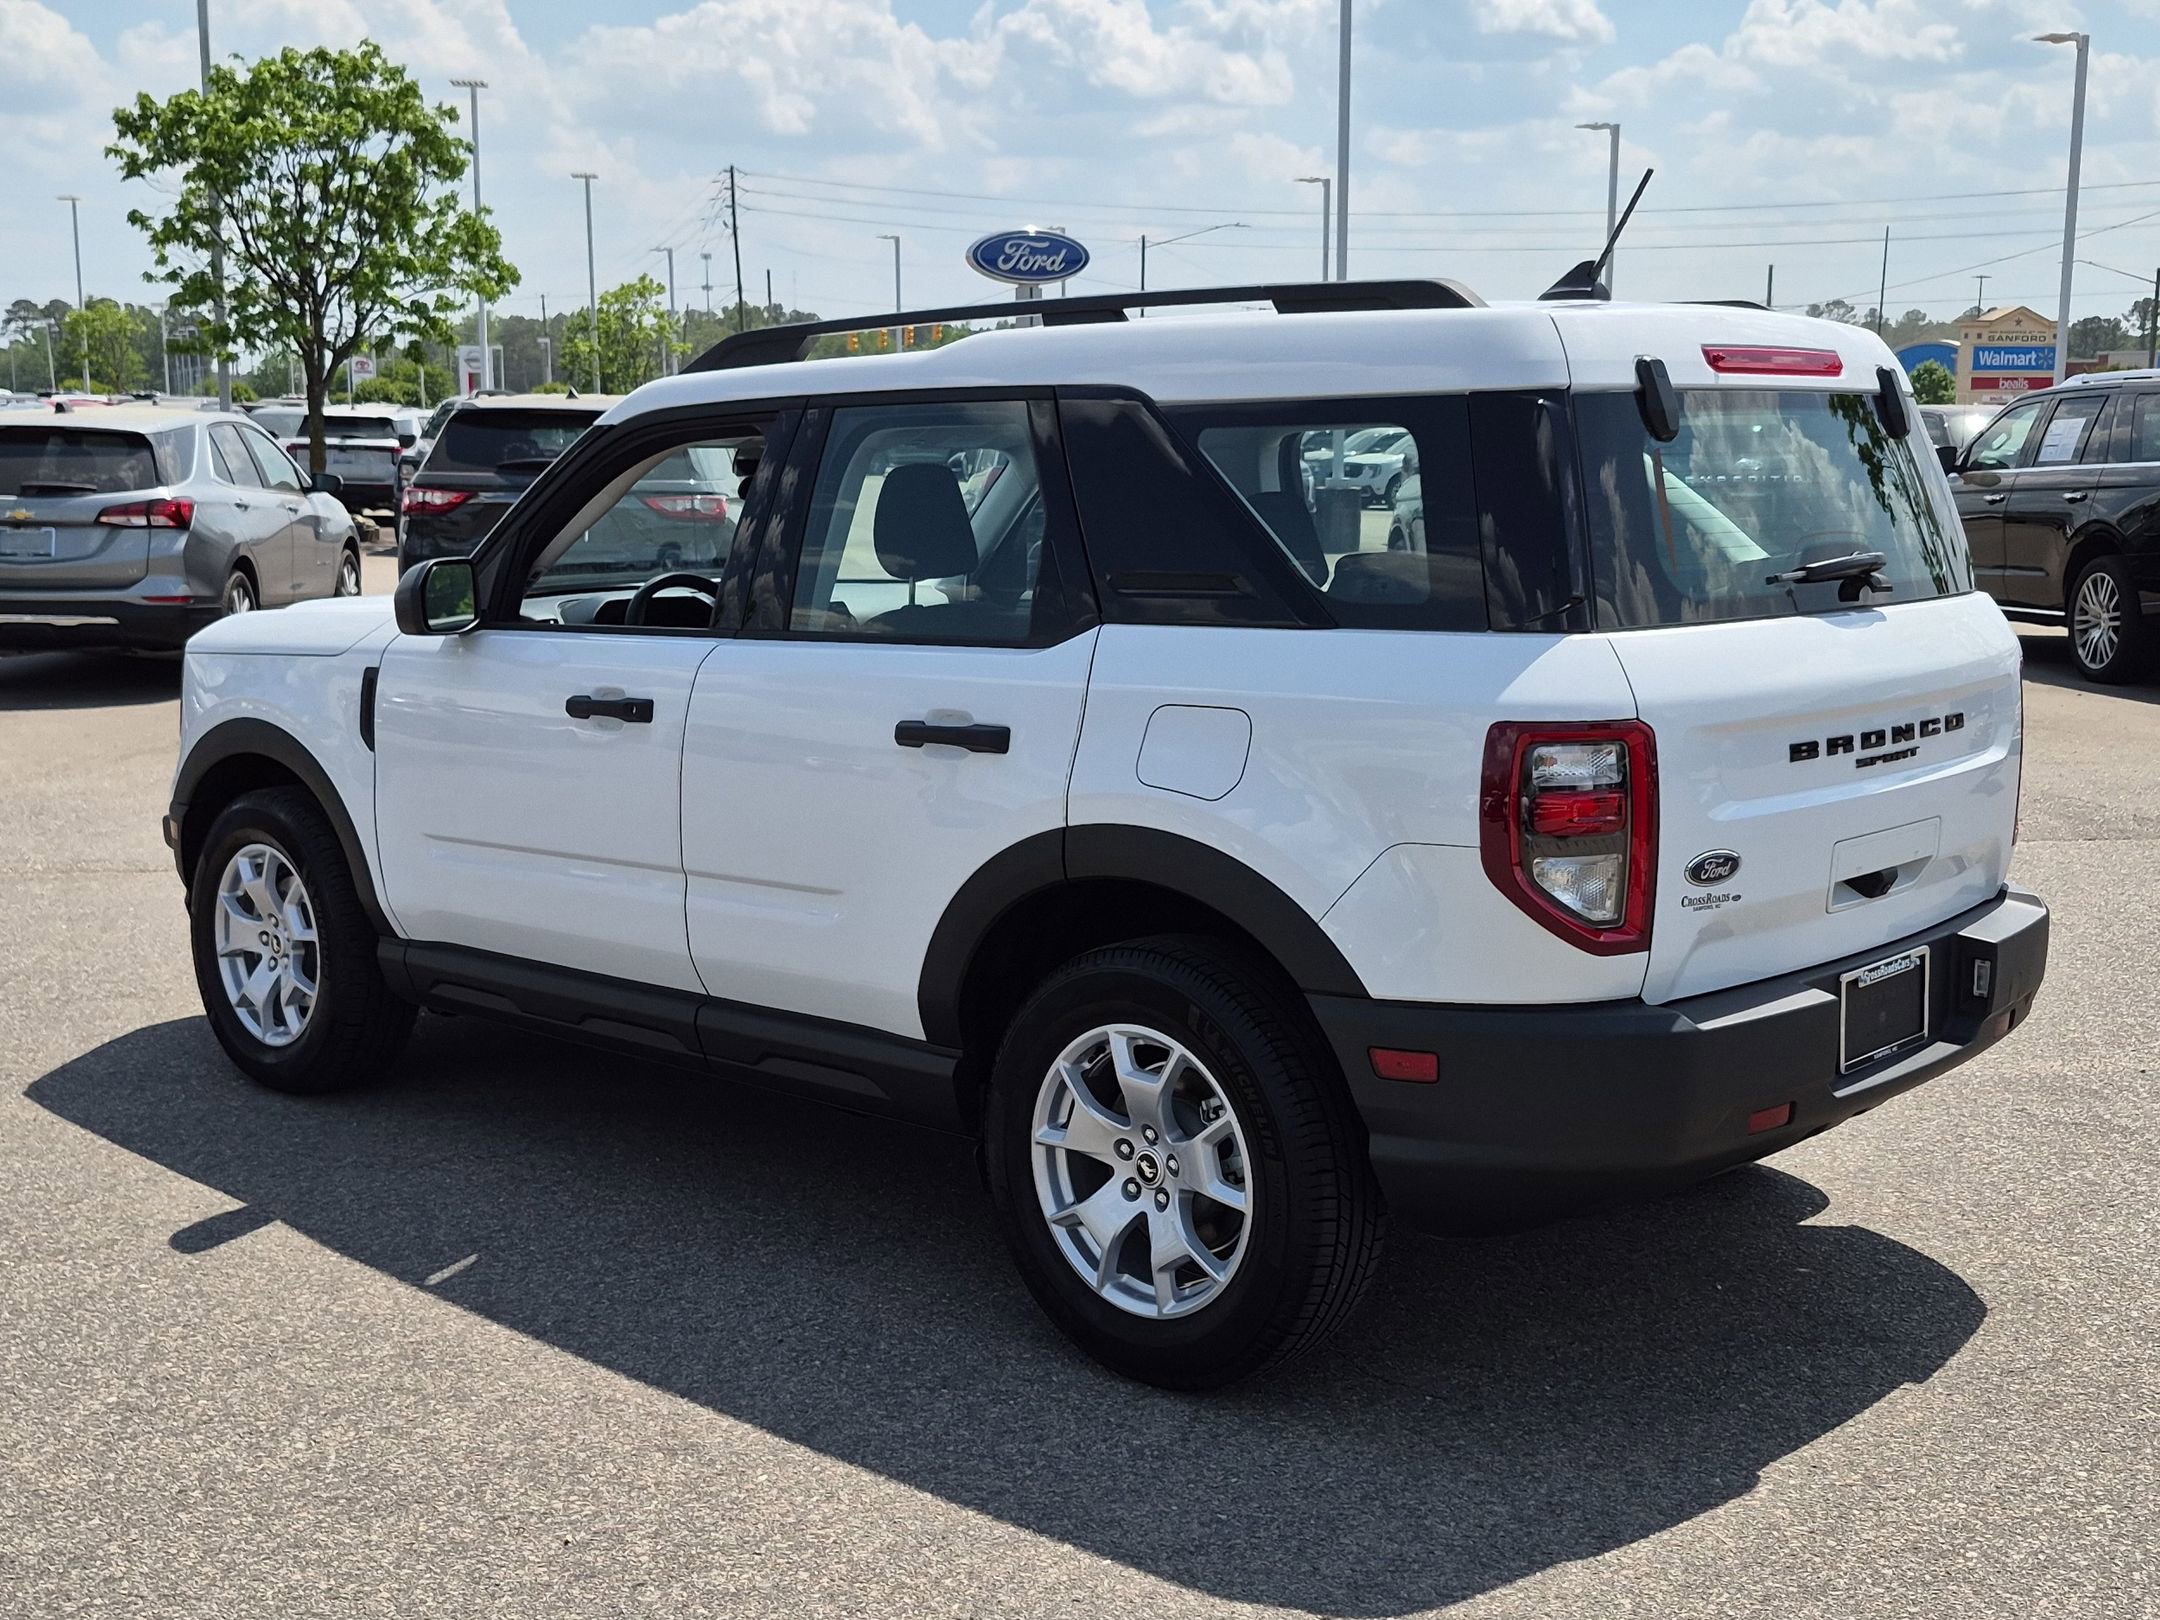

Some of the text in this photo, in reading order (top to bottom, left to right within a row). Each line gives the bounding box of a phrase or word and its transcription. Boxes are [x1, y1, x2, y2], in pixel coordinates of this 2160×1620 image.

[997, 240, 1067, 272] Ford
[1979, 350, 2038, 366] Walmart
[1999, 377, 2029, 390] bealls
[1789, 712, 1965, 763] BRONCO
[1855, 746, 1921, 769] SPORT
[1700, 858, 1732, 879] Ford
